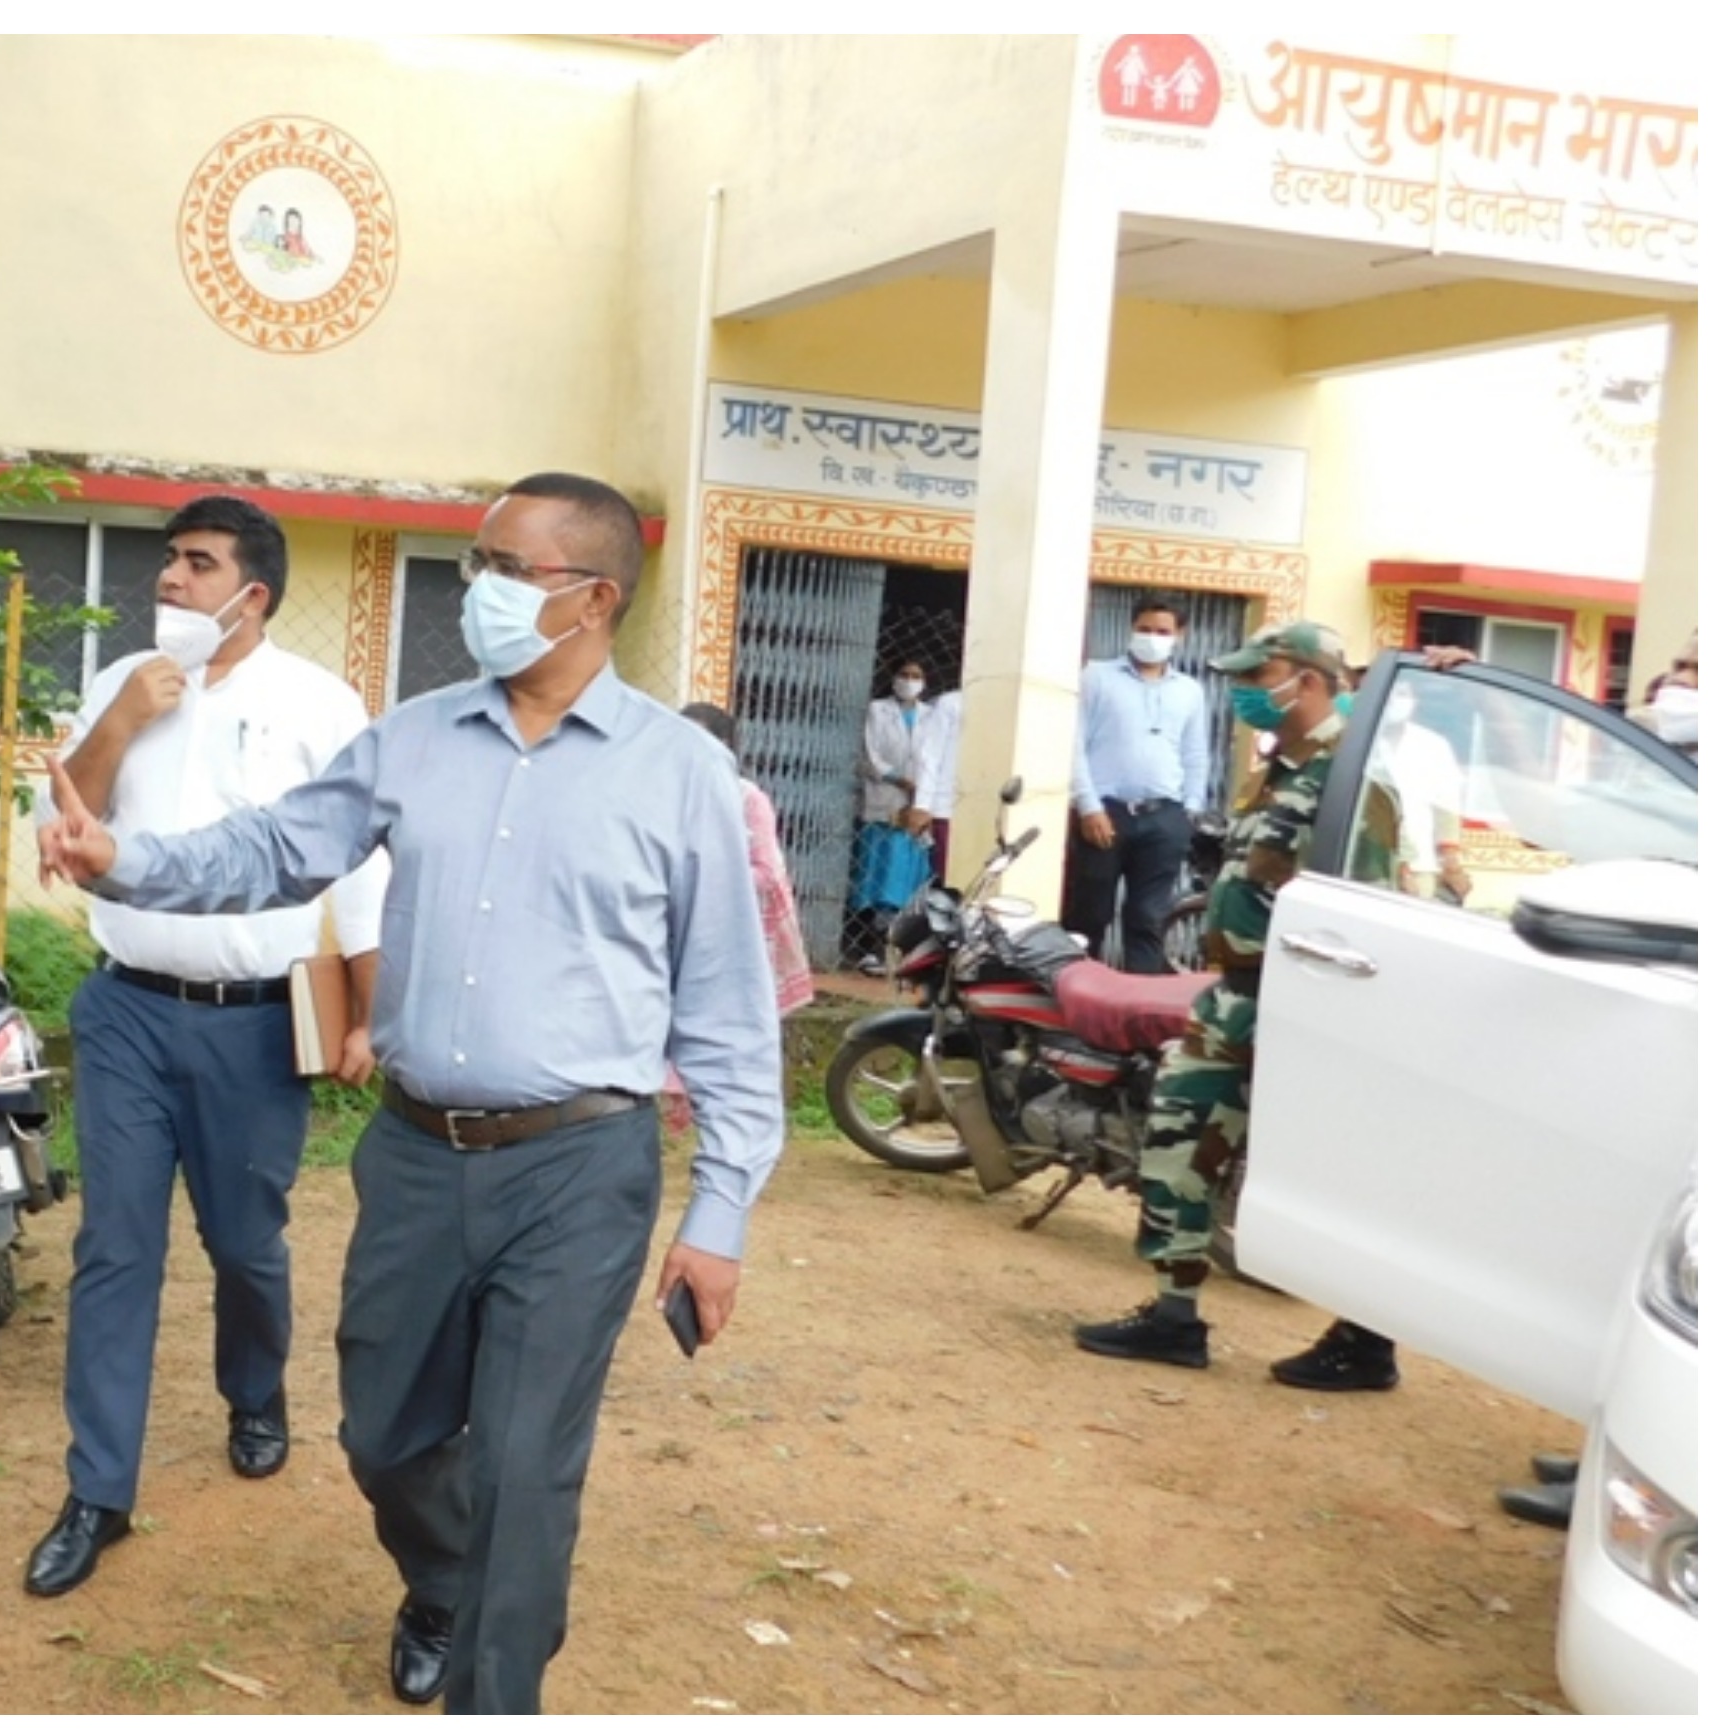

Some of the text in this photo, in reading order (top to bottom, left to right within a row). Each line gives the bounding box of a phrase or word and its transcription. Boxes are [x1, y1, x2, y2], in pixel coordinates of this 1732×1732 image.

[1241, 40, 1698, 199] आयुष्मान भार
[1270, 149, 1355, 208] हेल्थ
[1144, 449, 1263, 503] नगर
